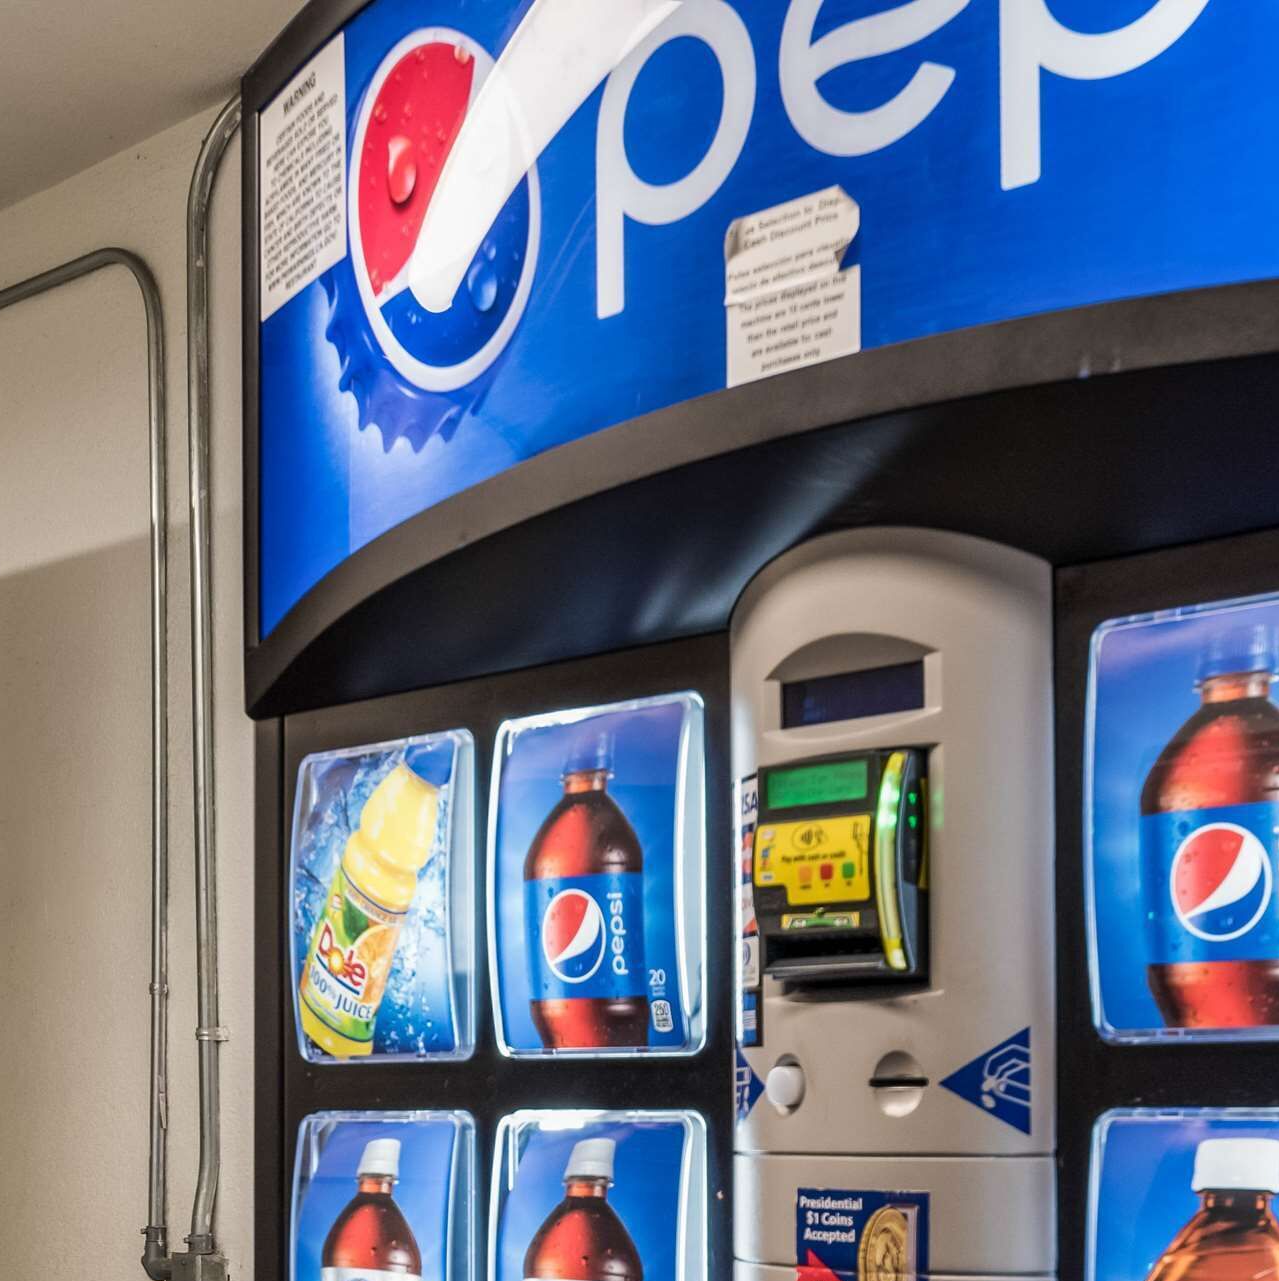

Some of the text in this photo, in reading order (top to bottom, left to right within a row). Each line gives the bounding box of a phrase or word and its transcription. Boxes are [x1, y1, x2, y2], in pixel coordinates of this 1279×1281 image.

[283, 70, 316, 117] WARNING
[606, 892, 629, 976] pepsi
[318, 923, 366, 987] Dole
[648, 968, 666, 986] 20
[334, 994, 373, 1019] JUICE
[799, 1196, 863, 1210] Presidential
[806, 1211, 854, 1226] $1 Coins
[803, 1228, 856, 1244] Accepted
